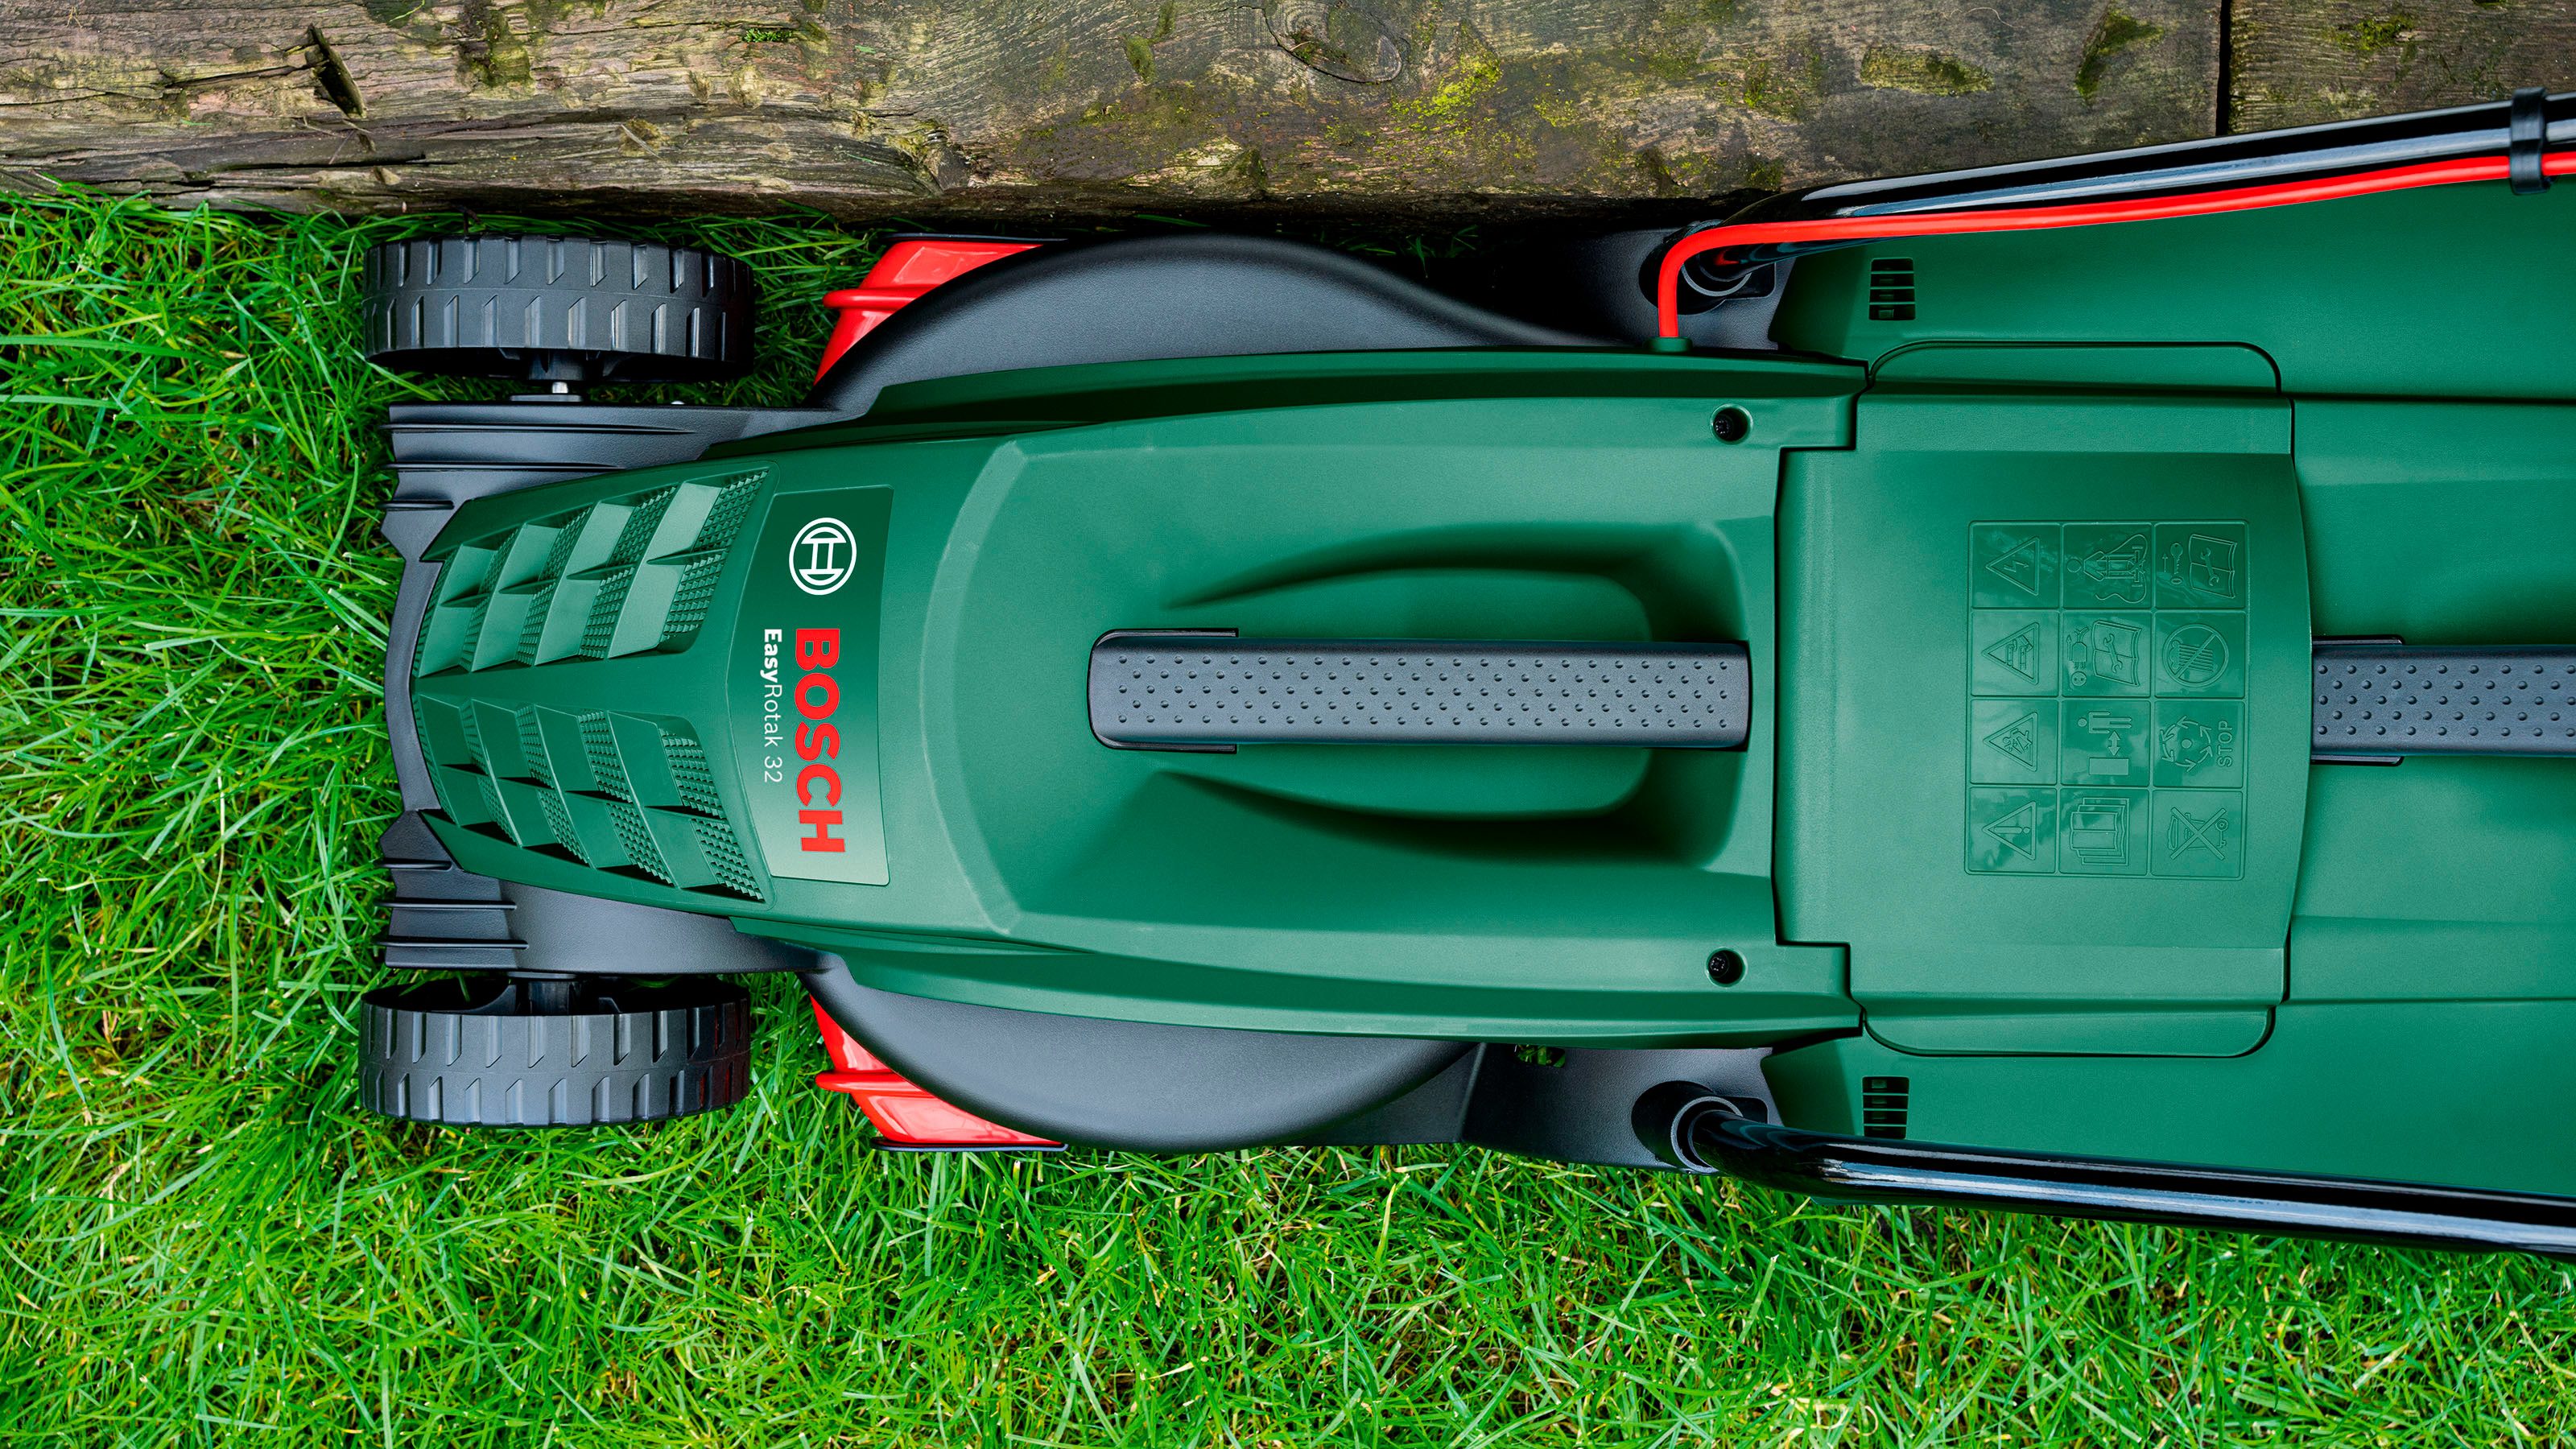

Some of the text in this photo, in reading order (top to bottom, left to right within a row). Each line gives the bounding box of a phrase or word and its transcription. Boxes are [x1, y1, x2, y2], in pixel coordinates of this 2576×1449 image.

[760, 629, 783, 783] EasyRotak 32
[795, 629, 845, 852] BOSCH
[2217, 720, 2233, 768] STOP
